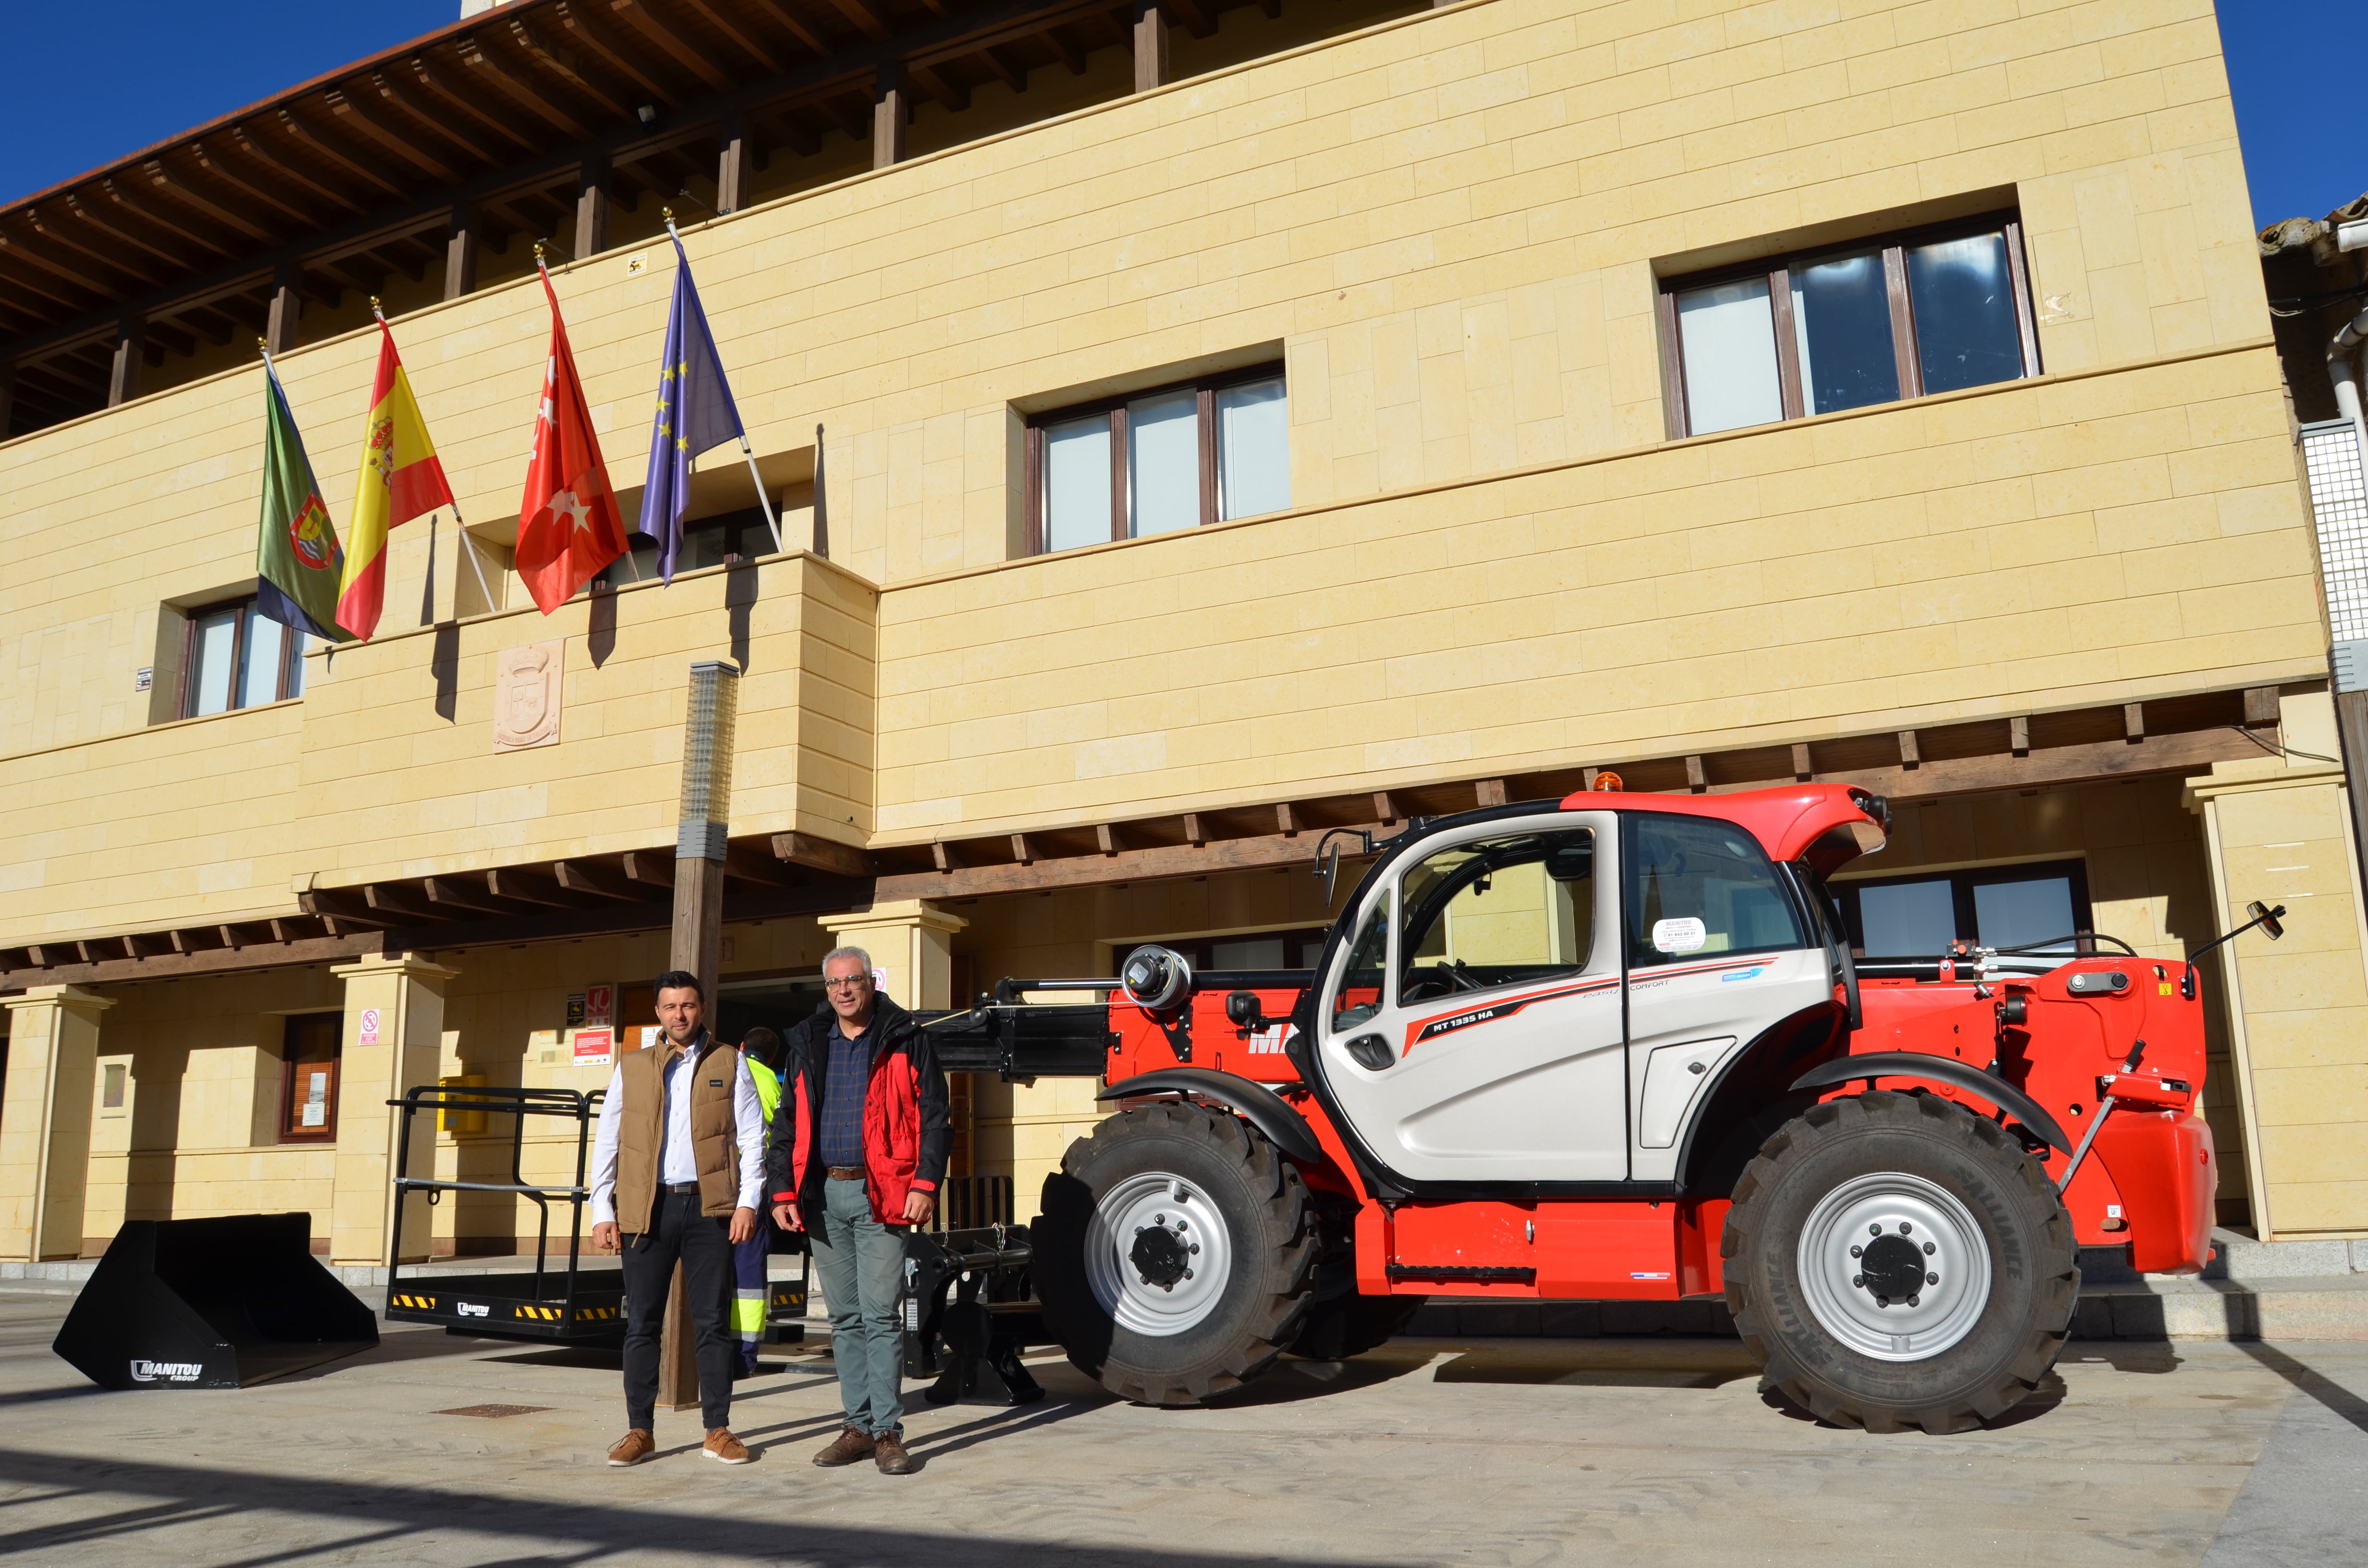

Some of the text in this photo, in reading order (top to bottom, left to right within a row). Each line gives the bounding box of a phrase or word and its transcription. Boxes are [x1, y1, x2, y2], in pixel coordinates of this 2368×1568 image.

[1583, 980, 1670, 999] easy COMFORT
[1433, 1010, 1493, 1032] MT 1335 HA
[1962, 1180, 2023, 1280] ALLIANCE
[462, 1304, 490, 1313] MANITOU
[140, 1362, 203, 1375] MANITOU
